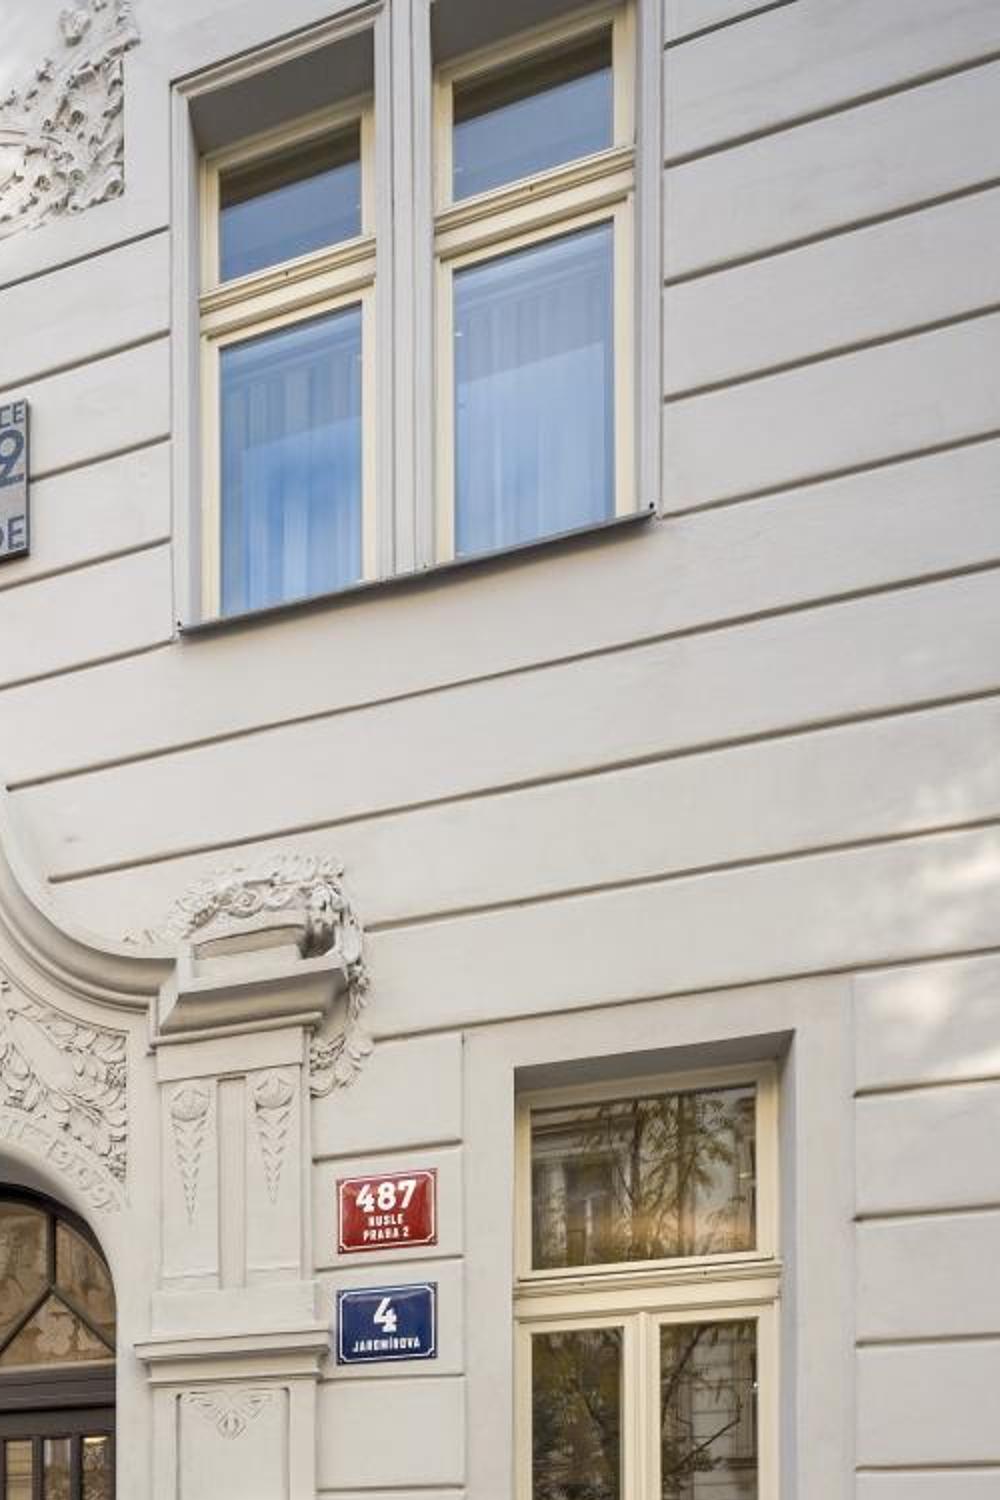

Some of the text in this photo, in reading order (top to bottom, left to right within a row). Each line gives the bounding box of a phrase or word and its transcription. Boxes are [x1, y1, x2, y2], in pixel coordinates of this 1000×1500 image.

[356, 1180, 417, 1213] 487
[402, 1226, 409, 1237] 2
[373, 1297, 397, 1332] 4
